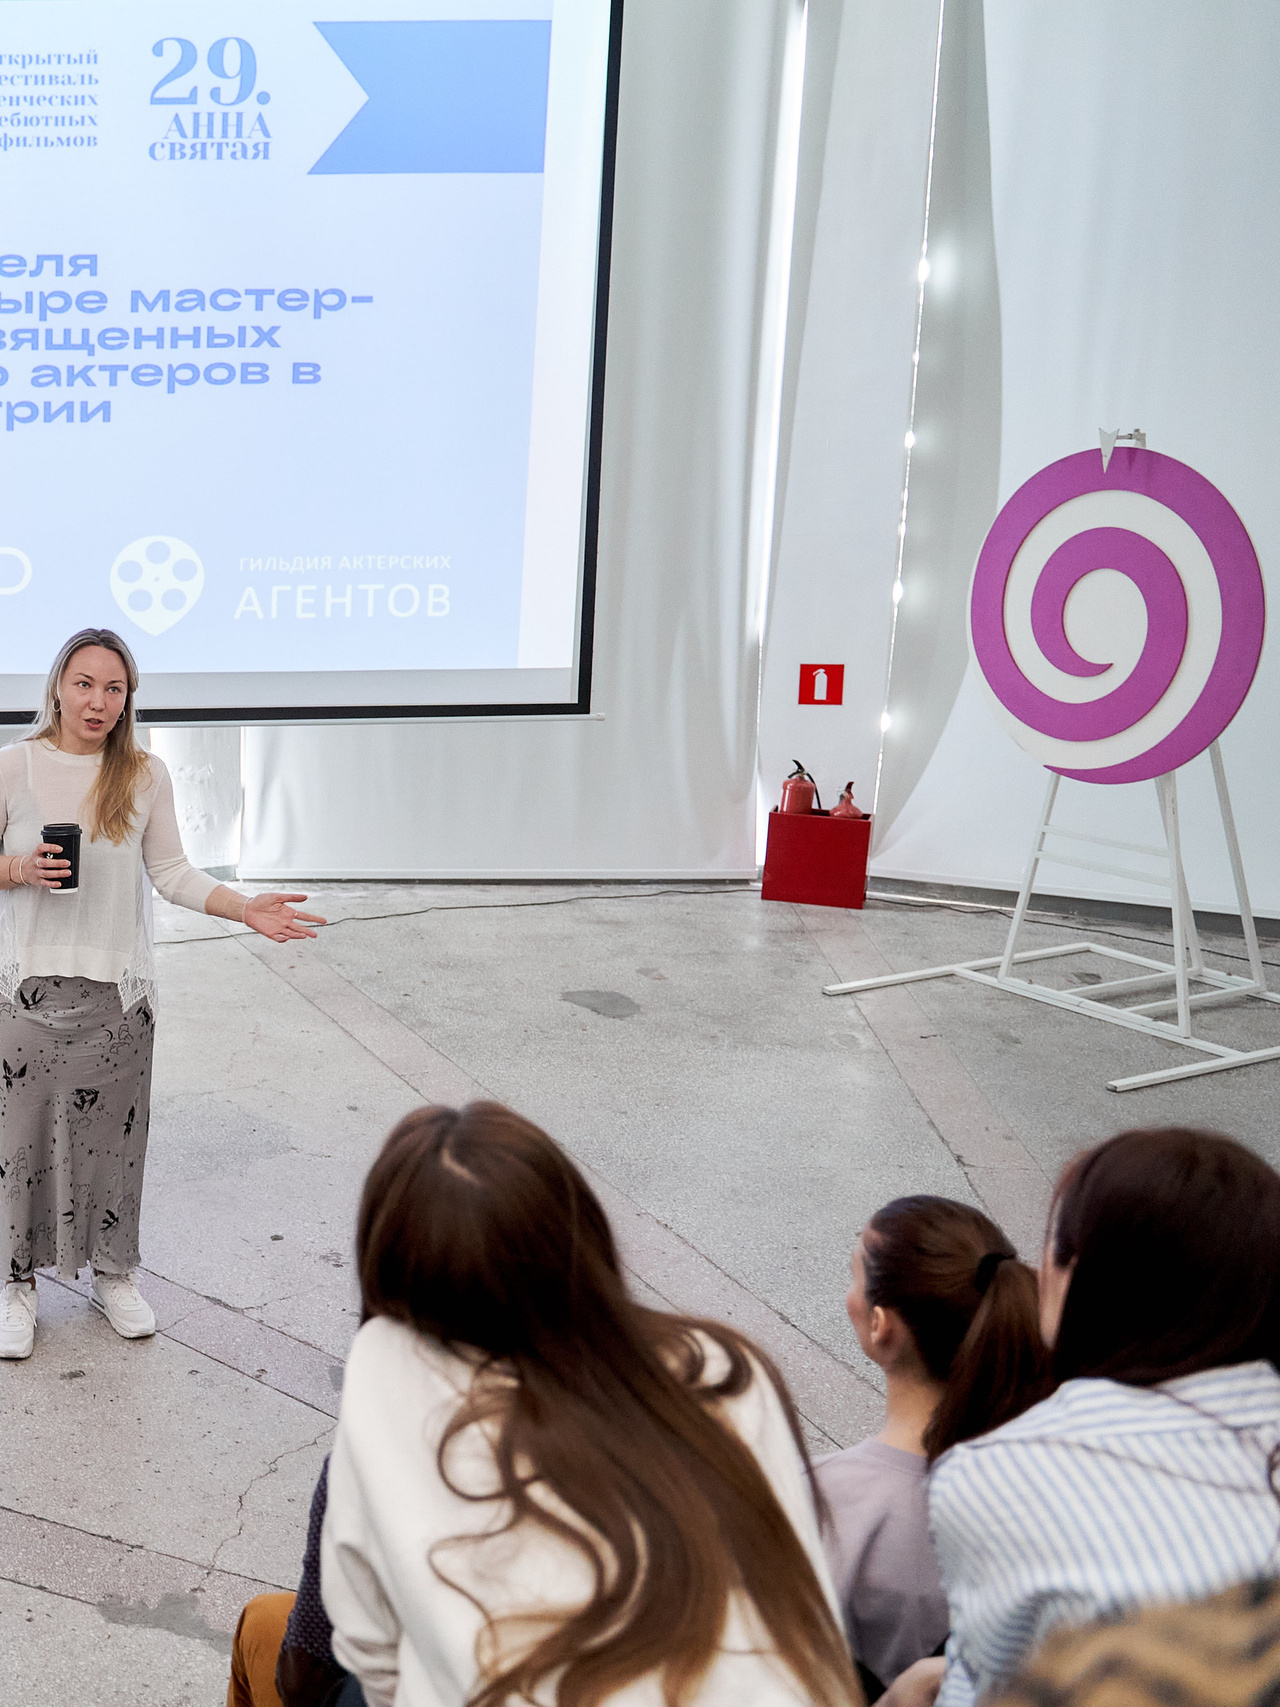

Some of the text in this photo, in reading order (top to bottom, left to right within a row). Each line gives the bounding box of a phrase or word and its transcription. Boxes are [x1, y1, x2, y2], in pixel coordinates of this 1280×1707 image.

[150, 37, 270, 105] 29.
[163, 111, 272, 139] АННА
[148, 141, 270, 161] святая
[130, 288, 373, 319] мастер-
[30, 362, 269, 393] актеров
[291, 362, 322, 384] в
[239, 555, 452, 574] ГИЛЬДИЯ АКТЕРСКИХ
[234, 584, 451, 620] АГЕНТОВ
